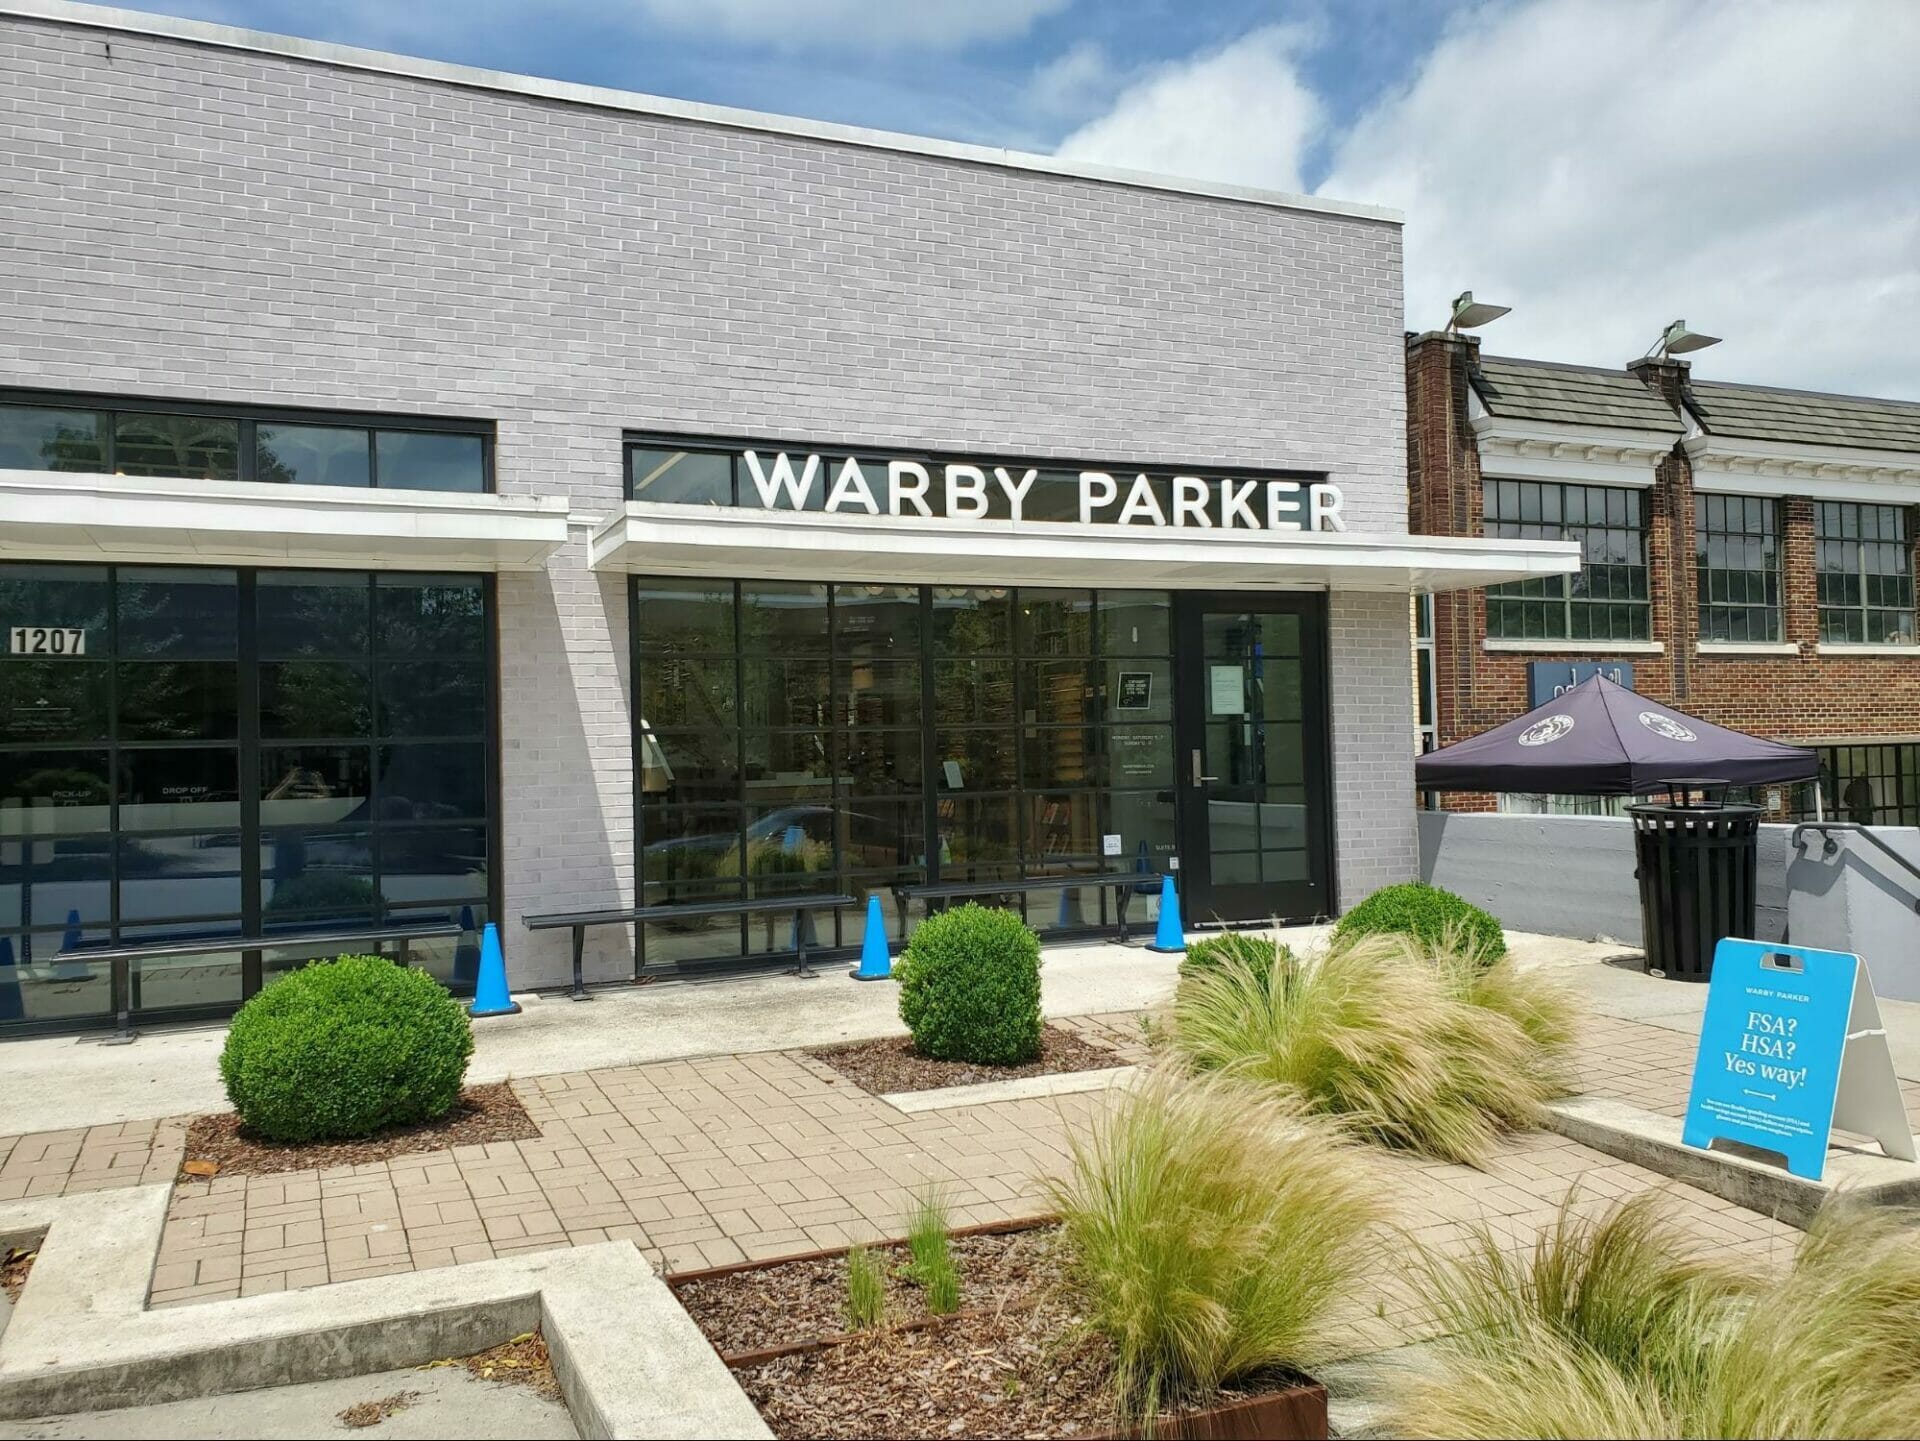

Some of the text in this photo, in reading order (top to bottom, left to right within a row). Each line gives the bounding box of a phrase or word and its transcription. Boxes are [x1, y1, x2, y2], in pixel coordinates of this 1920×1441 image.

[743, 450, 1348, 533] WARBY PARKER
[15, 628, 83, 654] 1207
[52, 790, 91, 798] PICK-UP
[162, 786, 208, 794] DROP OFF
[1745, 986, 1810, 1002] WARBY PARKER
[1746, 1011, 1798, 1037] FSA?
[1740, 1033, 1796, 1060] HSA?
[1724, 1052, 1807, 1090] Yes way!
